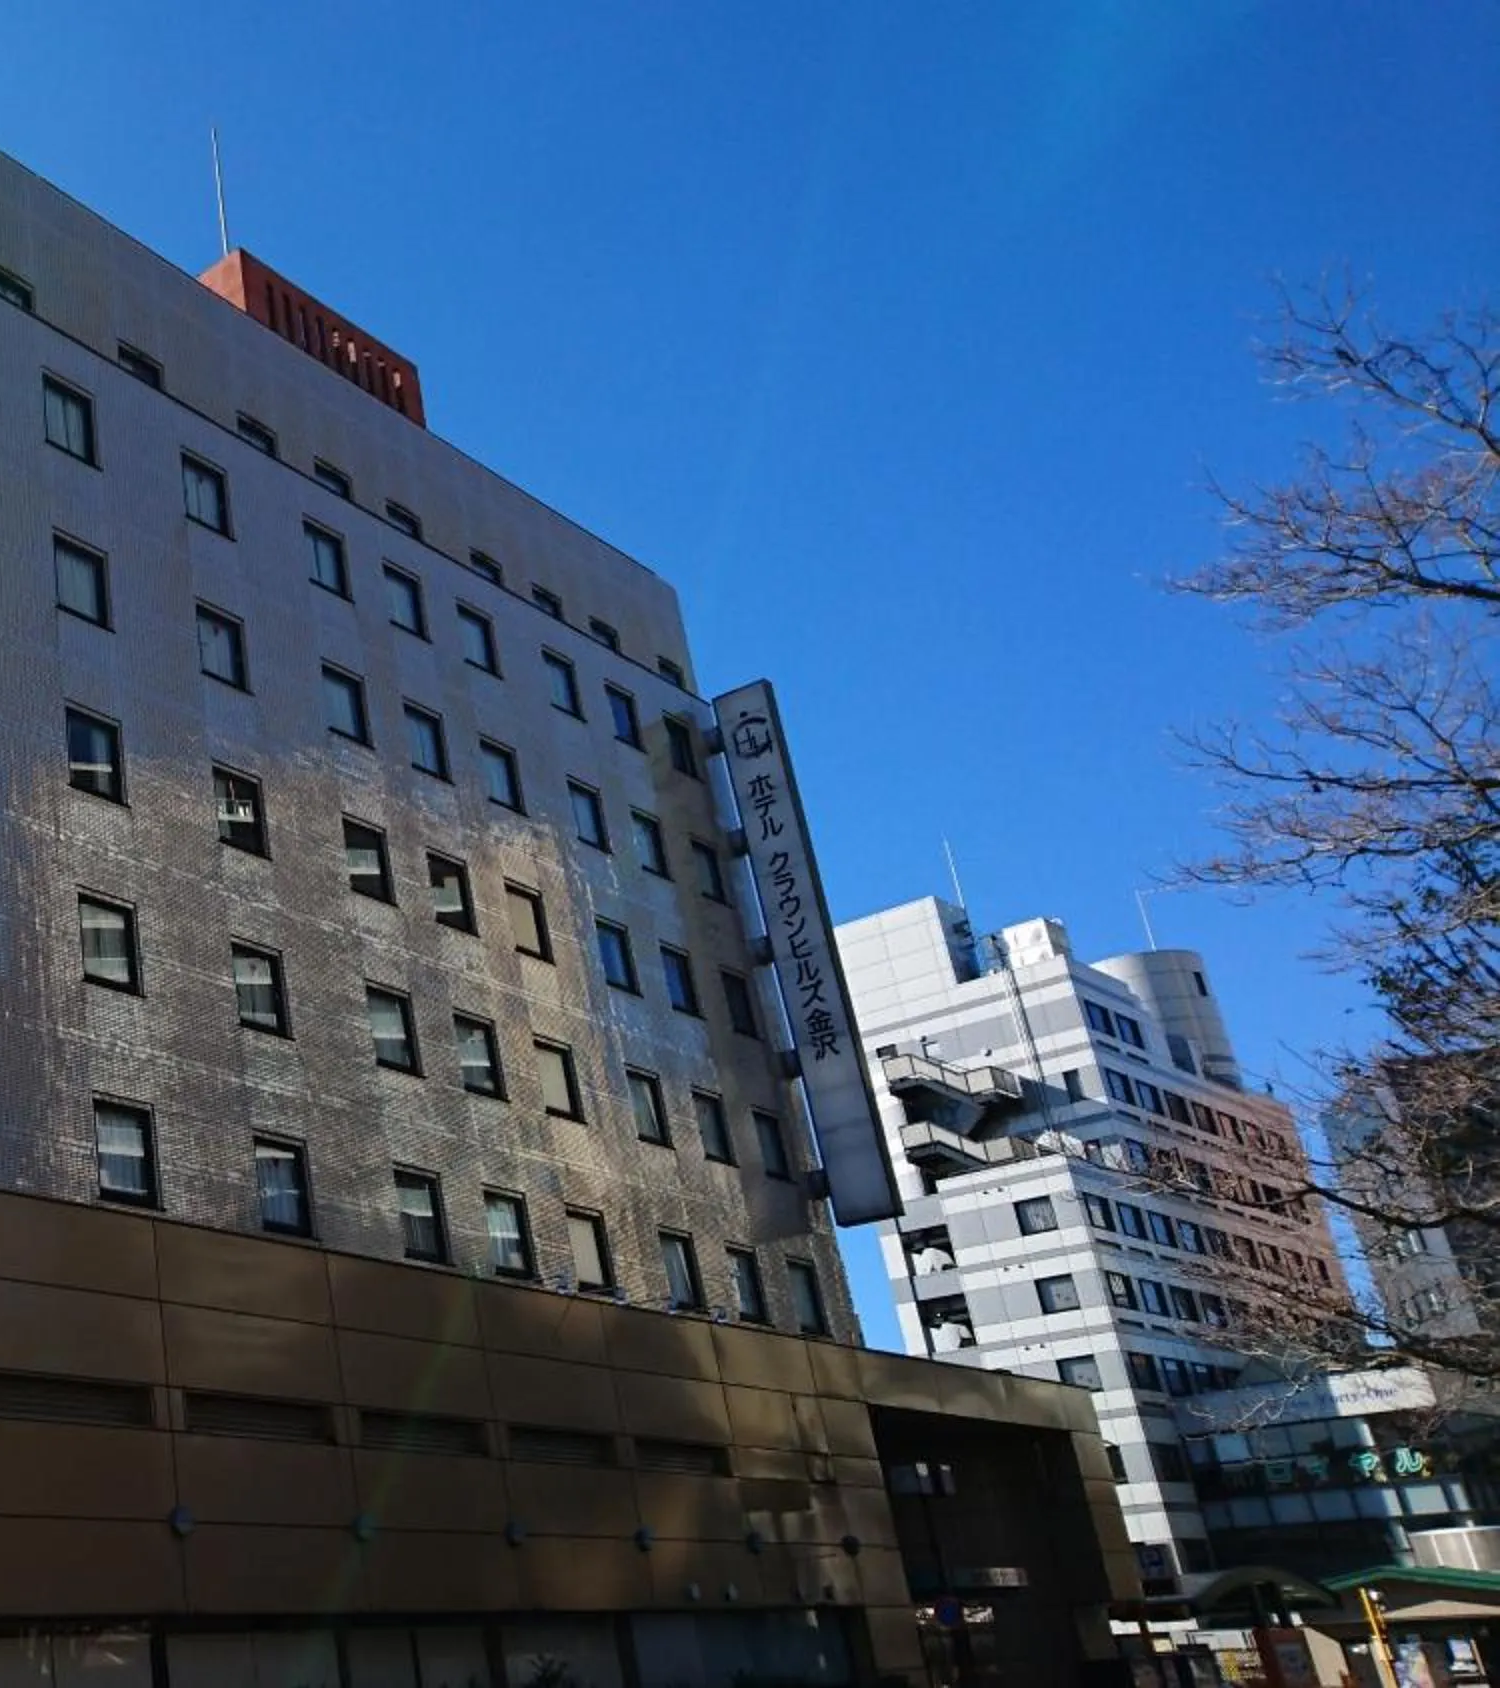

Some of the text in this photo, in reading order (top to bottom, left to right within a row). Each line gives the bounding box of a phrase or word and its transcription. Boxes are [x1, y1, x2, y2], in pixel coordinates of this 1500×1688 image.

[747, 774, 841, 1061] ホテル クラウンヒルズ金沢
